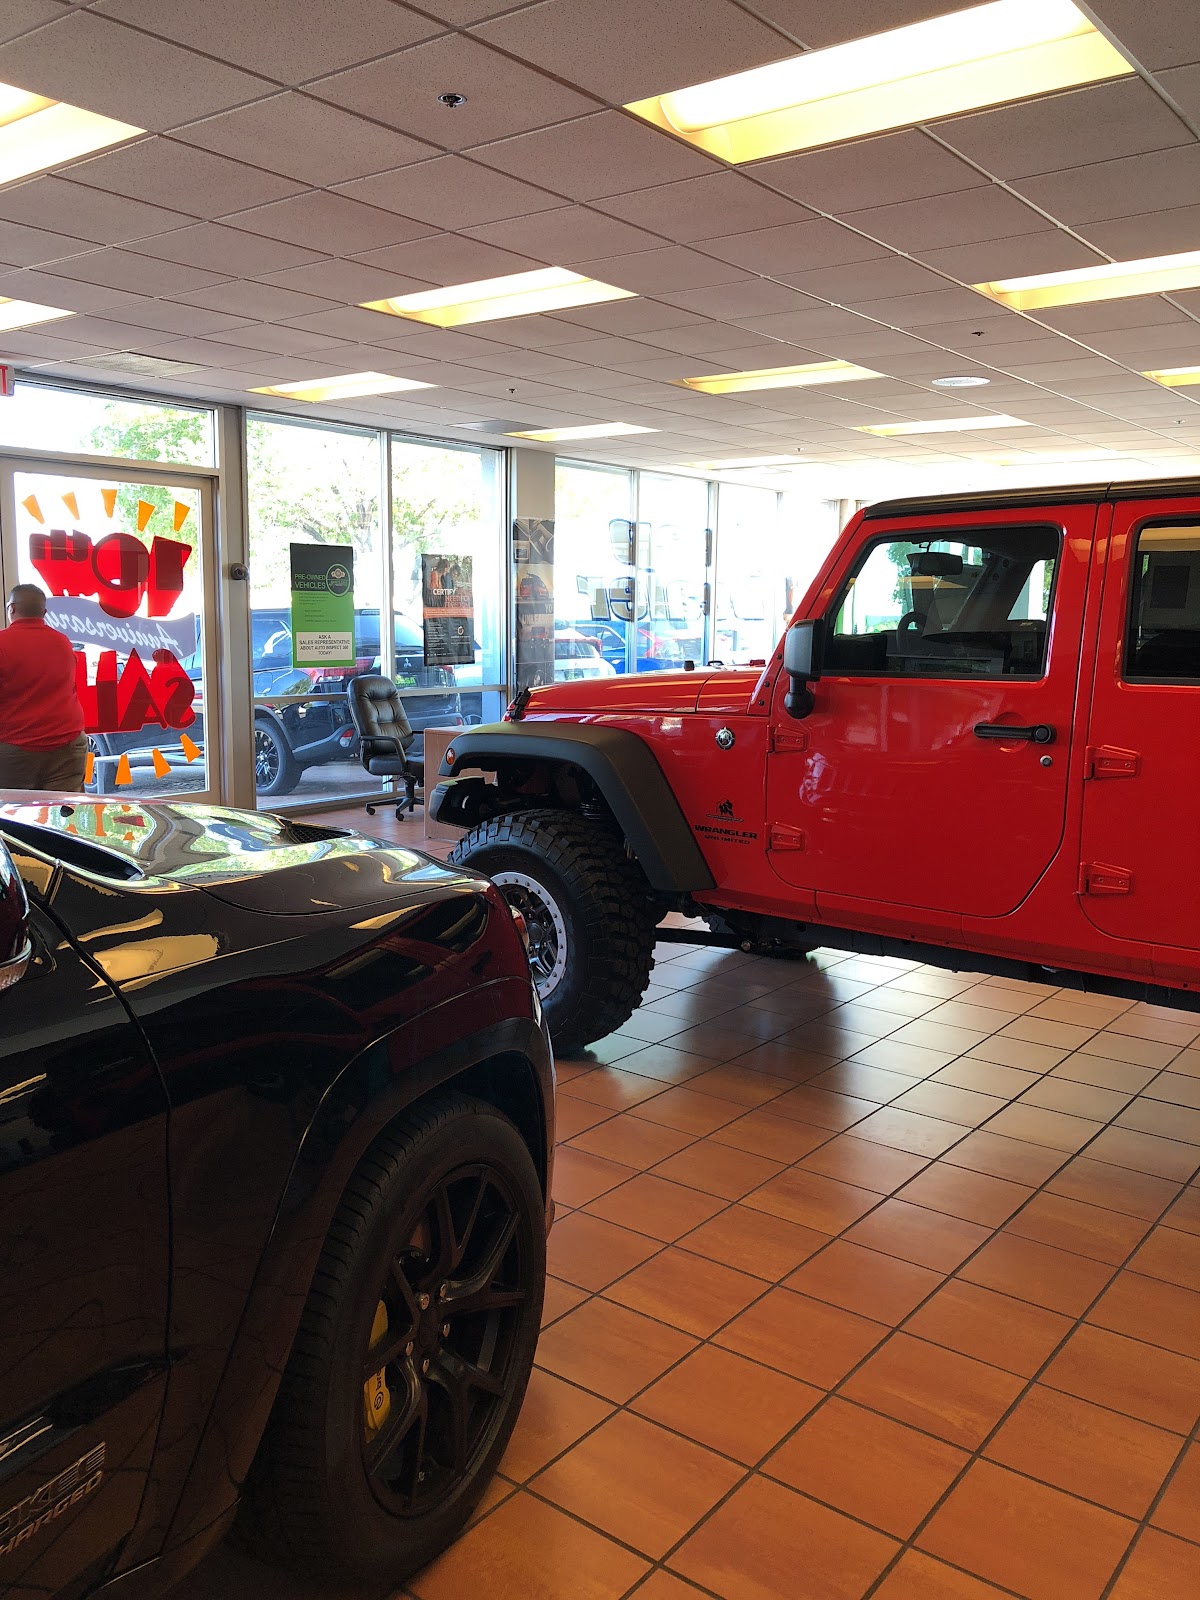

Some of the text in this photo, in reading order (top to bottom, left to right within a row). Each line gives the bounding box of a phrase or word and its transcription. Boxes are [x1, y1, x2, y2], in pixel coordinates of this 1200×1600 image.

[294, 573, 326, 581] PRE-OWNED
[294, 581, 326, 589] VEHICLES
[432, 588, 458, 596] CERTIFY
[694, 825, 758, 840] WRANGLER
[704, 834, 750, 845] UNLIMITED
